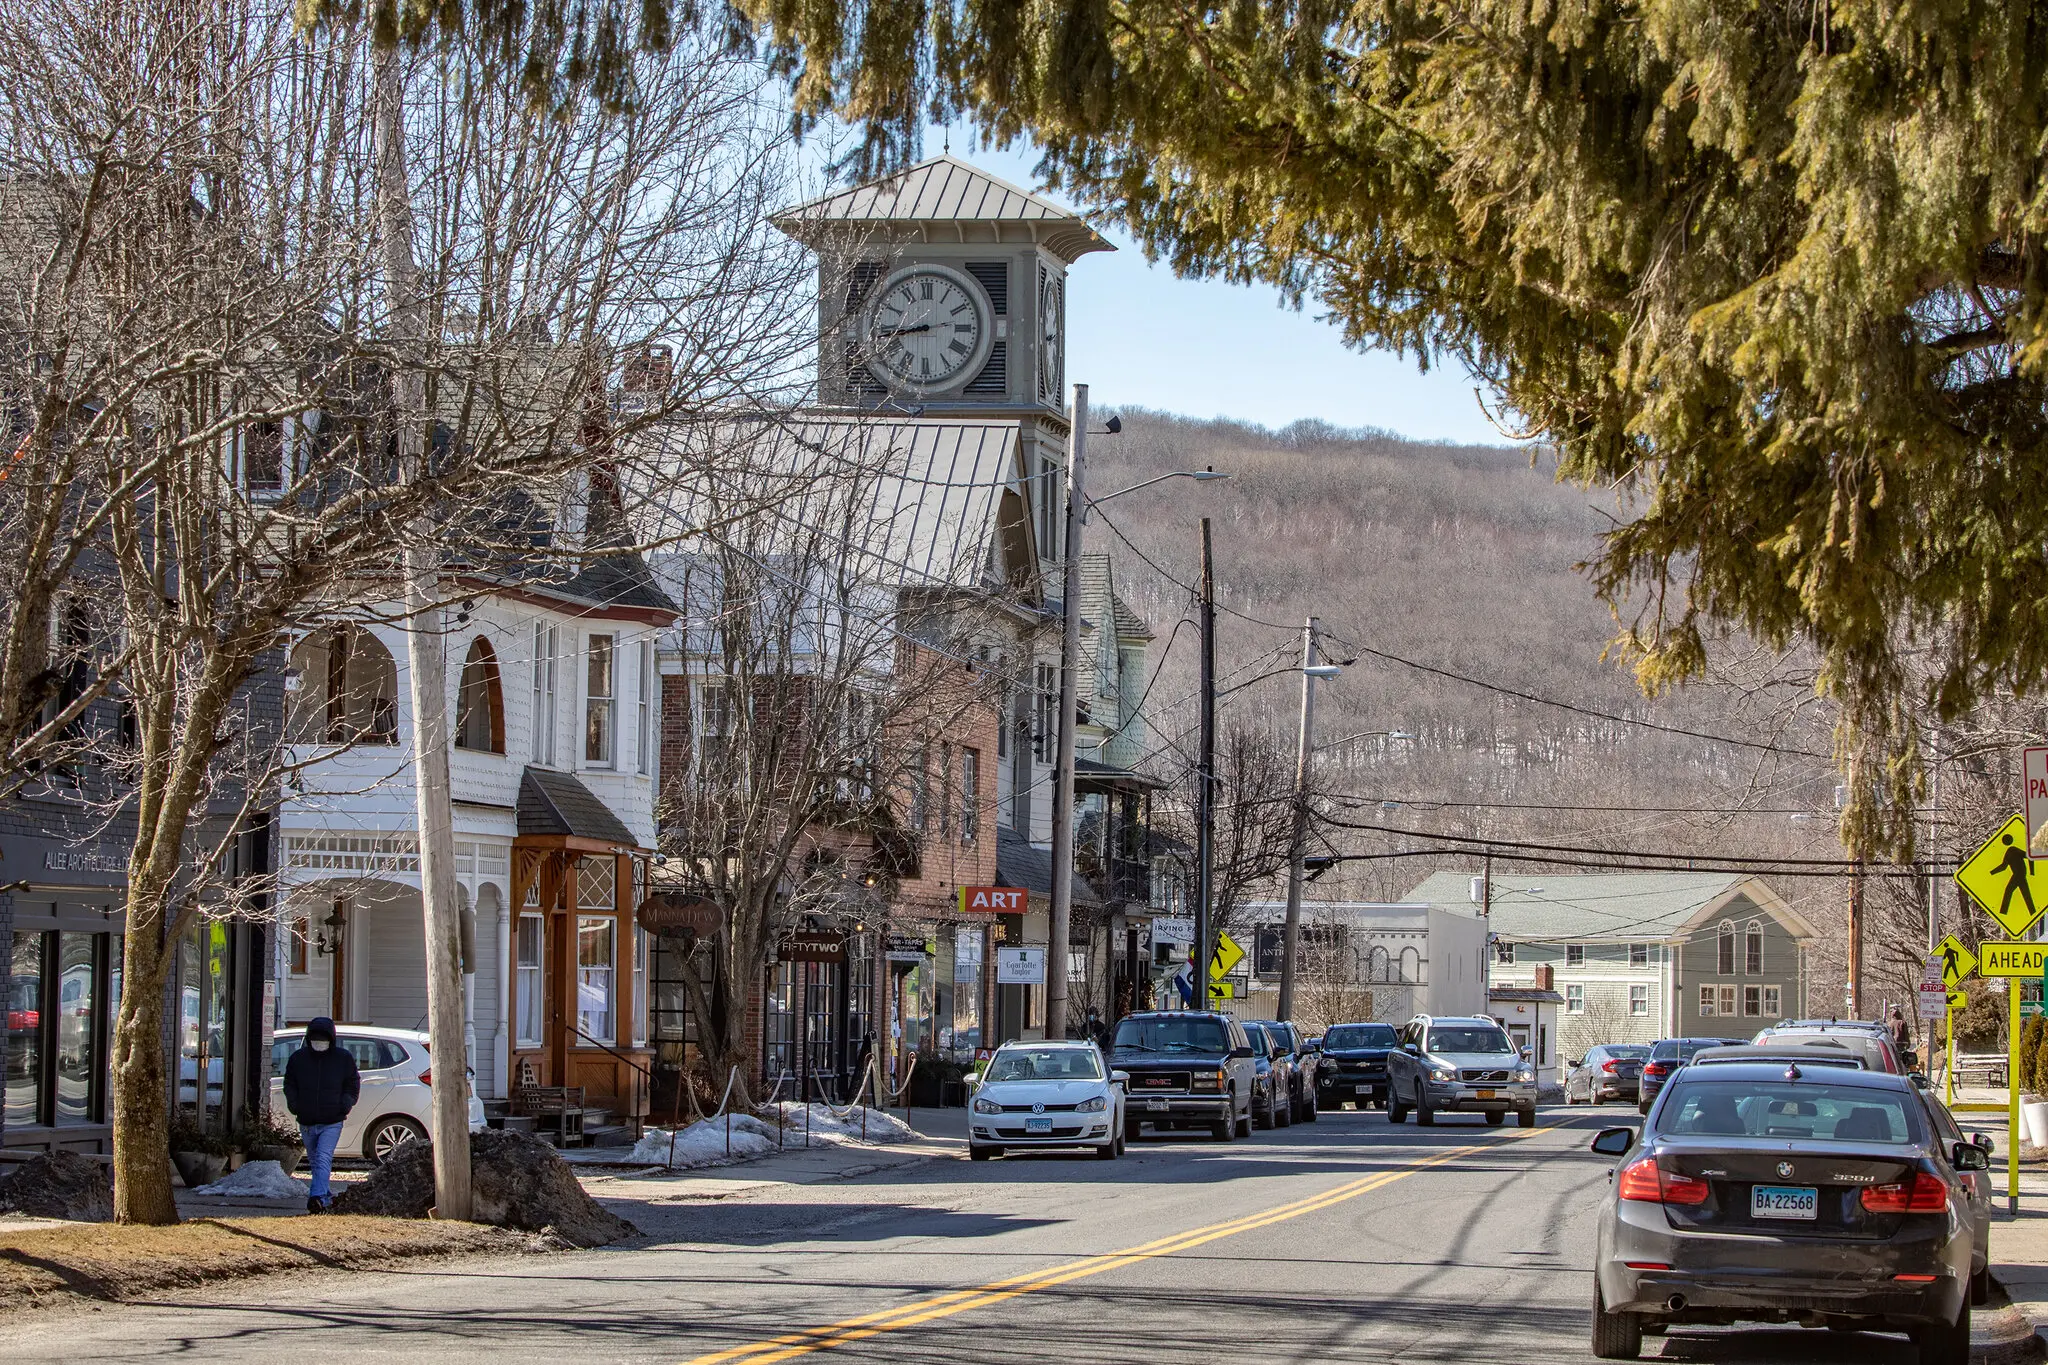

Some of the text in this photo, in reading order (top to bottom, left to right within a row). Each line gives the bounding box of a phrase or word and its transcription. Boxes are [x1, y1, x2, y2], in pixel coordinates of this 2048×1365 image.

[920, 283, 934, 300] XII
[940, 288, 951, 304] I
[950, 303, 967, 316] II
[46, 851, 67, 869] ALLEE
[972, 892, 1022, 908] ART
[1989, 952, 2043, 968] AHEAD
[1833, 1173, 1875, 1182] 328d
